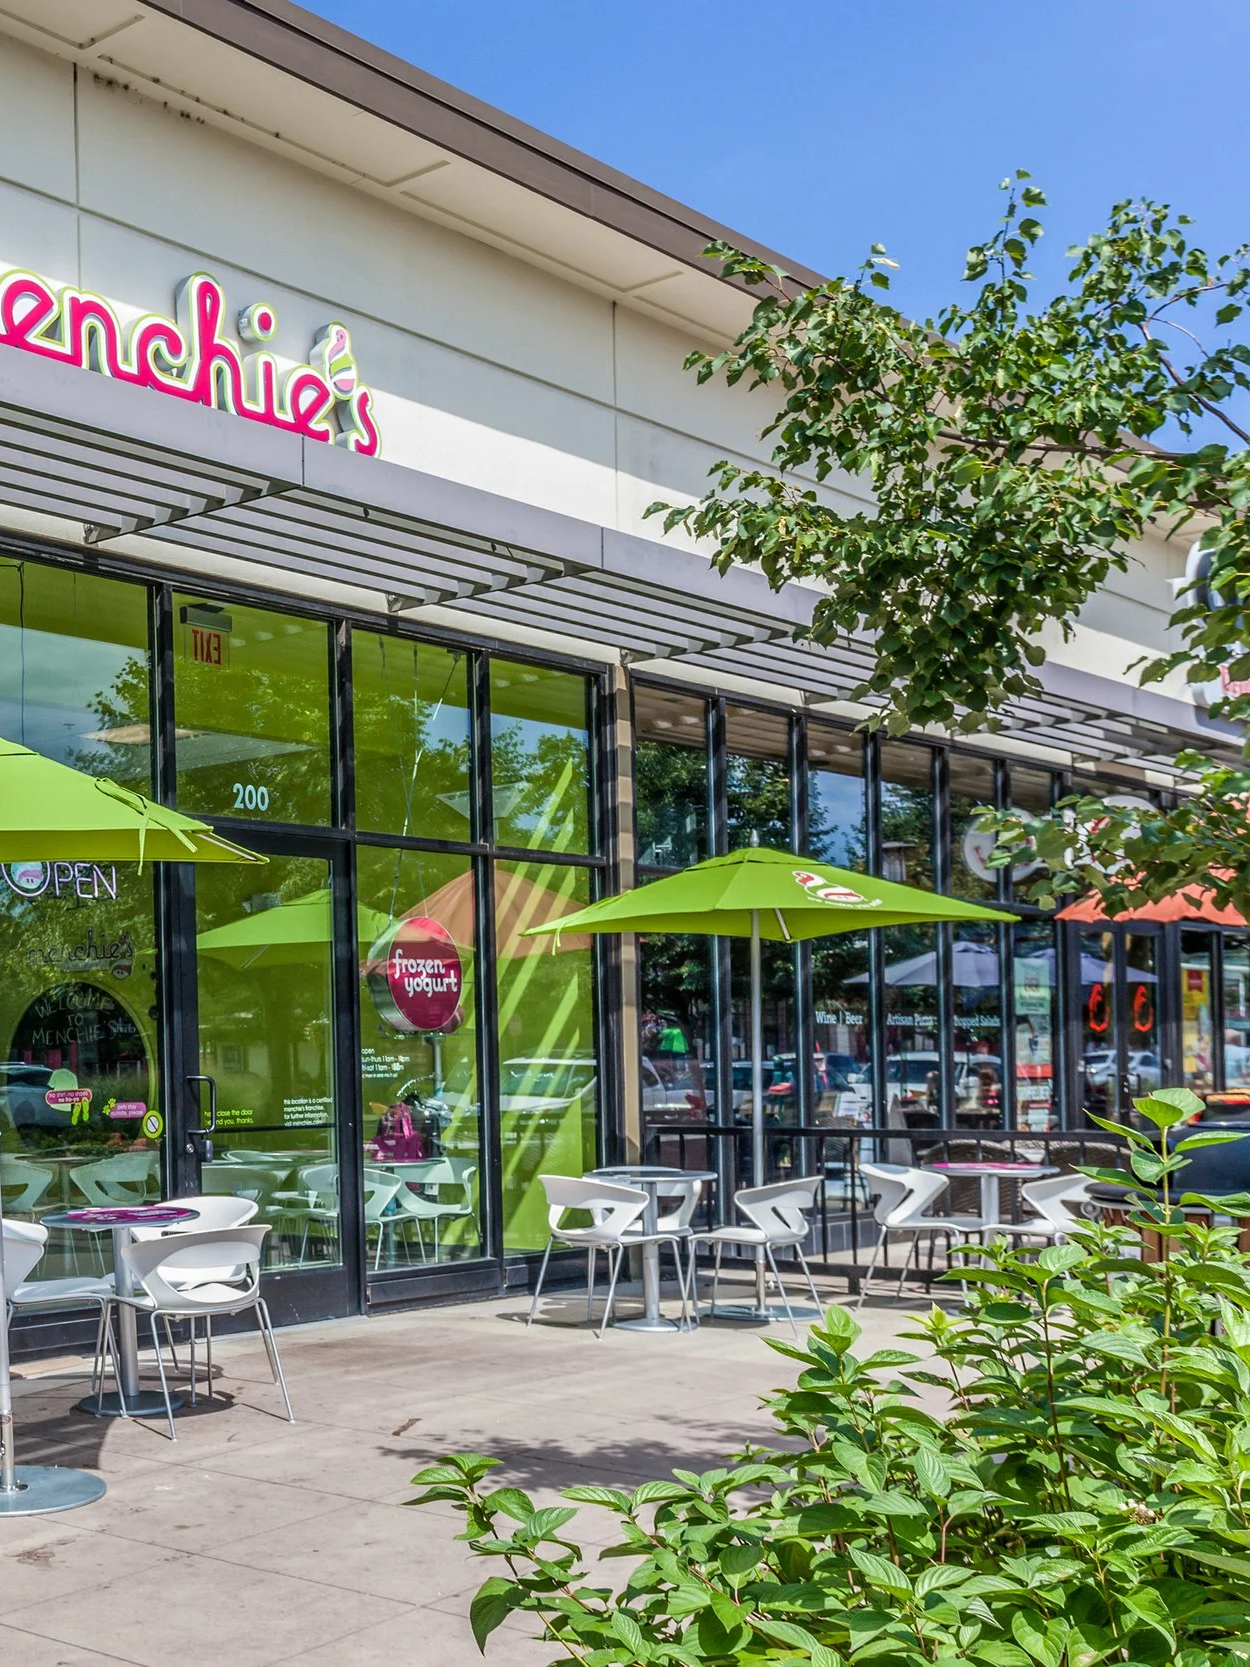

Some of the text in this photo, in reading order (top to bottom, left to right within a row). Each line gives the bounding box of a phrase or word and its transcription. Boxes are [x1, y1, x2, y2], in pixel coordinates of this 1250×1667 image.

[233, 783, 269, 811] 200
[1, 862, 116, 899] OPEN
[393, 949, 445, 980] frozen
[404, 970, 458, 998] yogurt
[67, 1013, 83, 1026] TO
[815, 1011, 837, 1024] Wine
[845, 1011, 863, 1024] Beer
[886, 1012, 913, 1025] Artisan
[954, 1013, 979, 1029] hopped
[32, 1021, 116, 1044] MENCHIE'S
[291, 1097, 308, 1105] location
[216, 1109, 231, 1117] close
[240, 1108, 253, 1116] door
